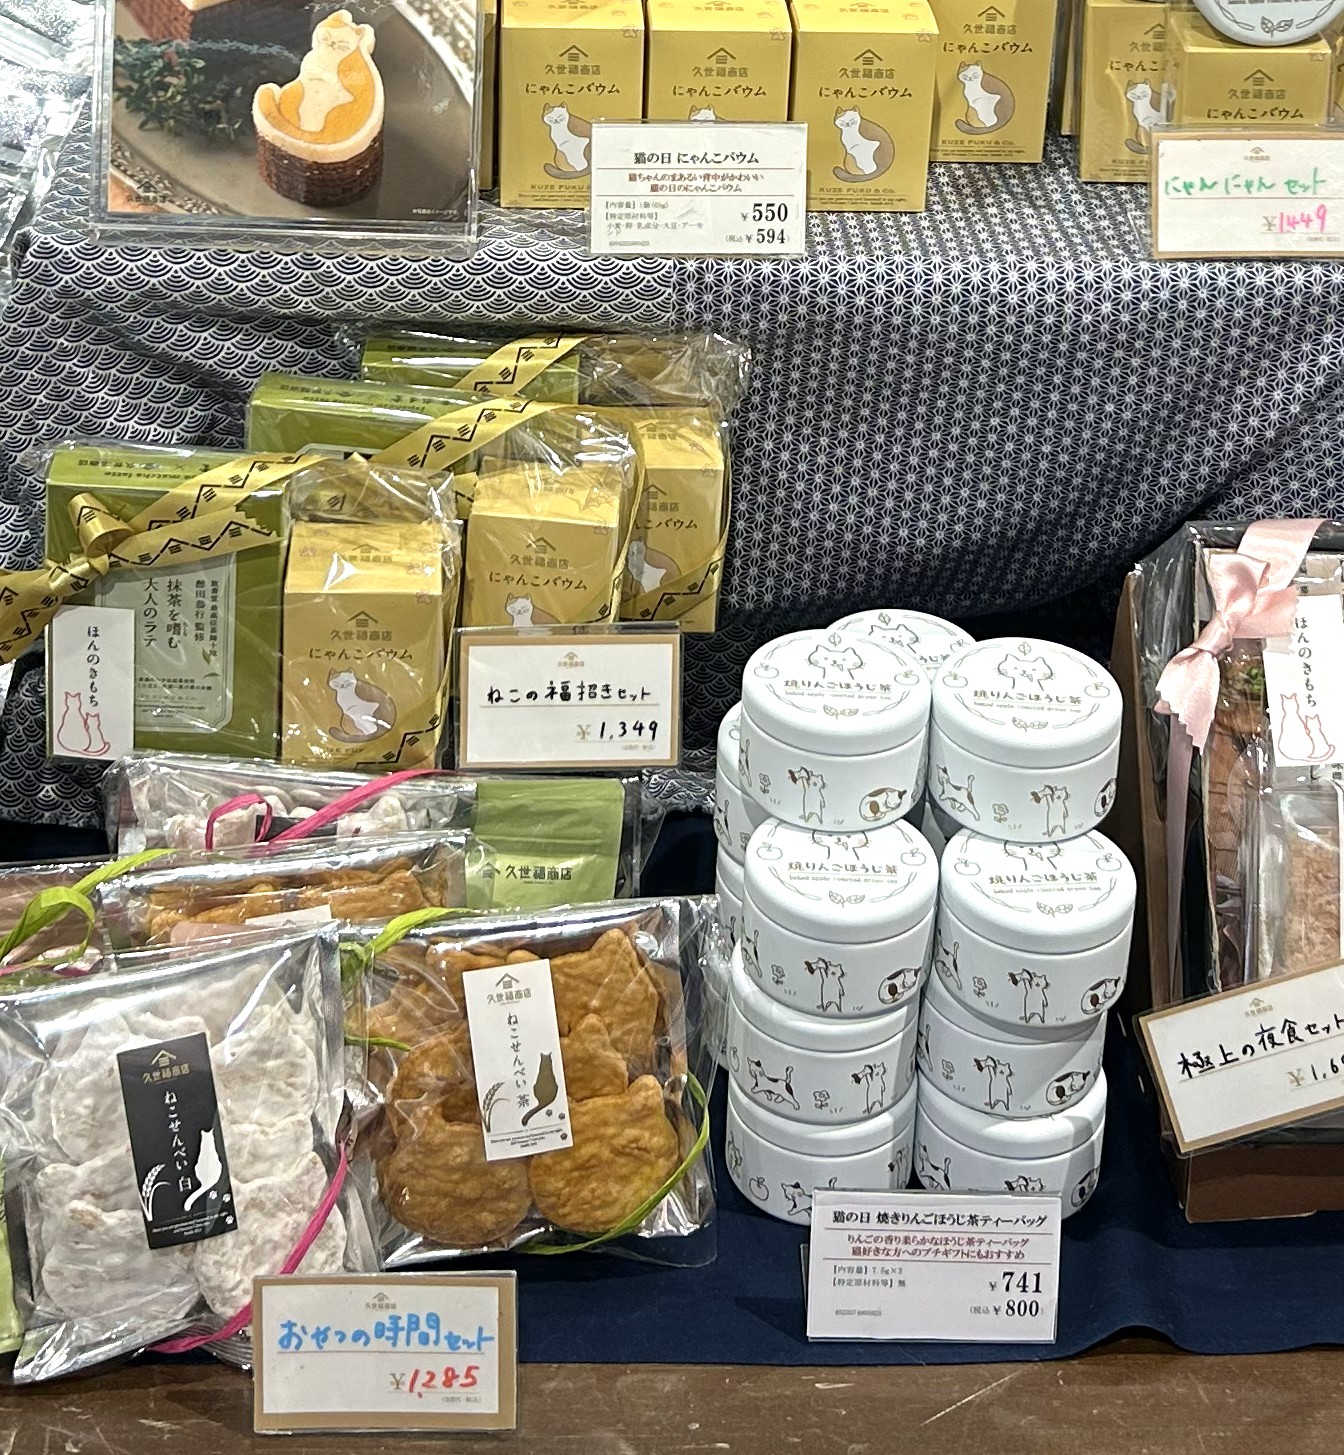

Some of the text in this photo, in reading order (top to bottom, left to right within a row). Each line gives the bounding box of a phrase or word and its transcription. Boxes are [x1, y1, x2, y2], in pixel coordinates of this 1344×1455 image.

[942, 41, 1033, 54] にゃんこバウム
[524, 82, 621, 97] にゃんこバウム
[672, 84, 767, 98] にゃんこバウム
[818, 86, 913, 100] にゃんこバウム
[1206, 107, 1305, 121] にゃんこバウム
[677, 152, 759, 164] にゃんこバウム
[489, 570, 588, 592] にゃんこバウム
[143, 578, 159, 647] 大人のラテ
[86, 625, 101, 707] ほんのきもち
[1293, 616, 1318, 708] ほんのきもち
[507, 1012, 530, 1109] ねこせんべい 茶
[165, 1091, 192, 1192] ねこせんべい 白
[832, 1210, 1048, 1228] 猫の日 焼きりんごほうじ茶ティーバッグ
[278, 1312, 495, 1352] おやつの時間セット
